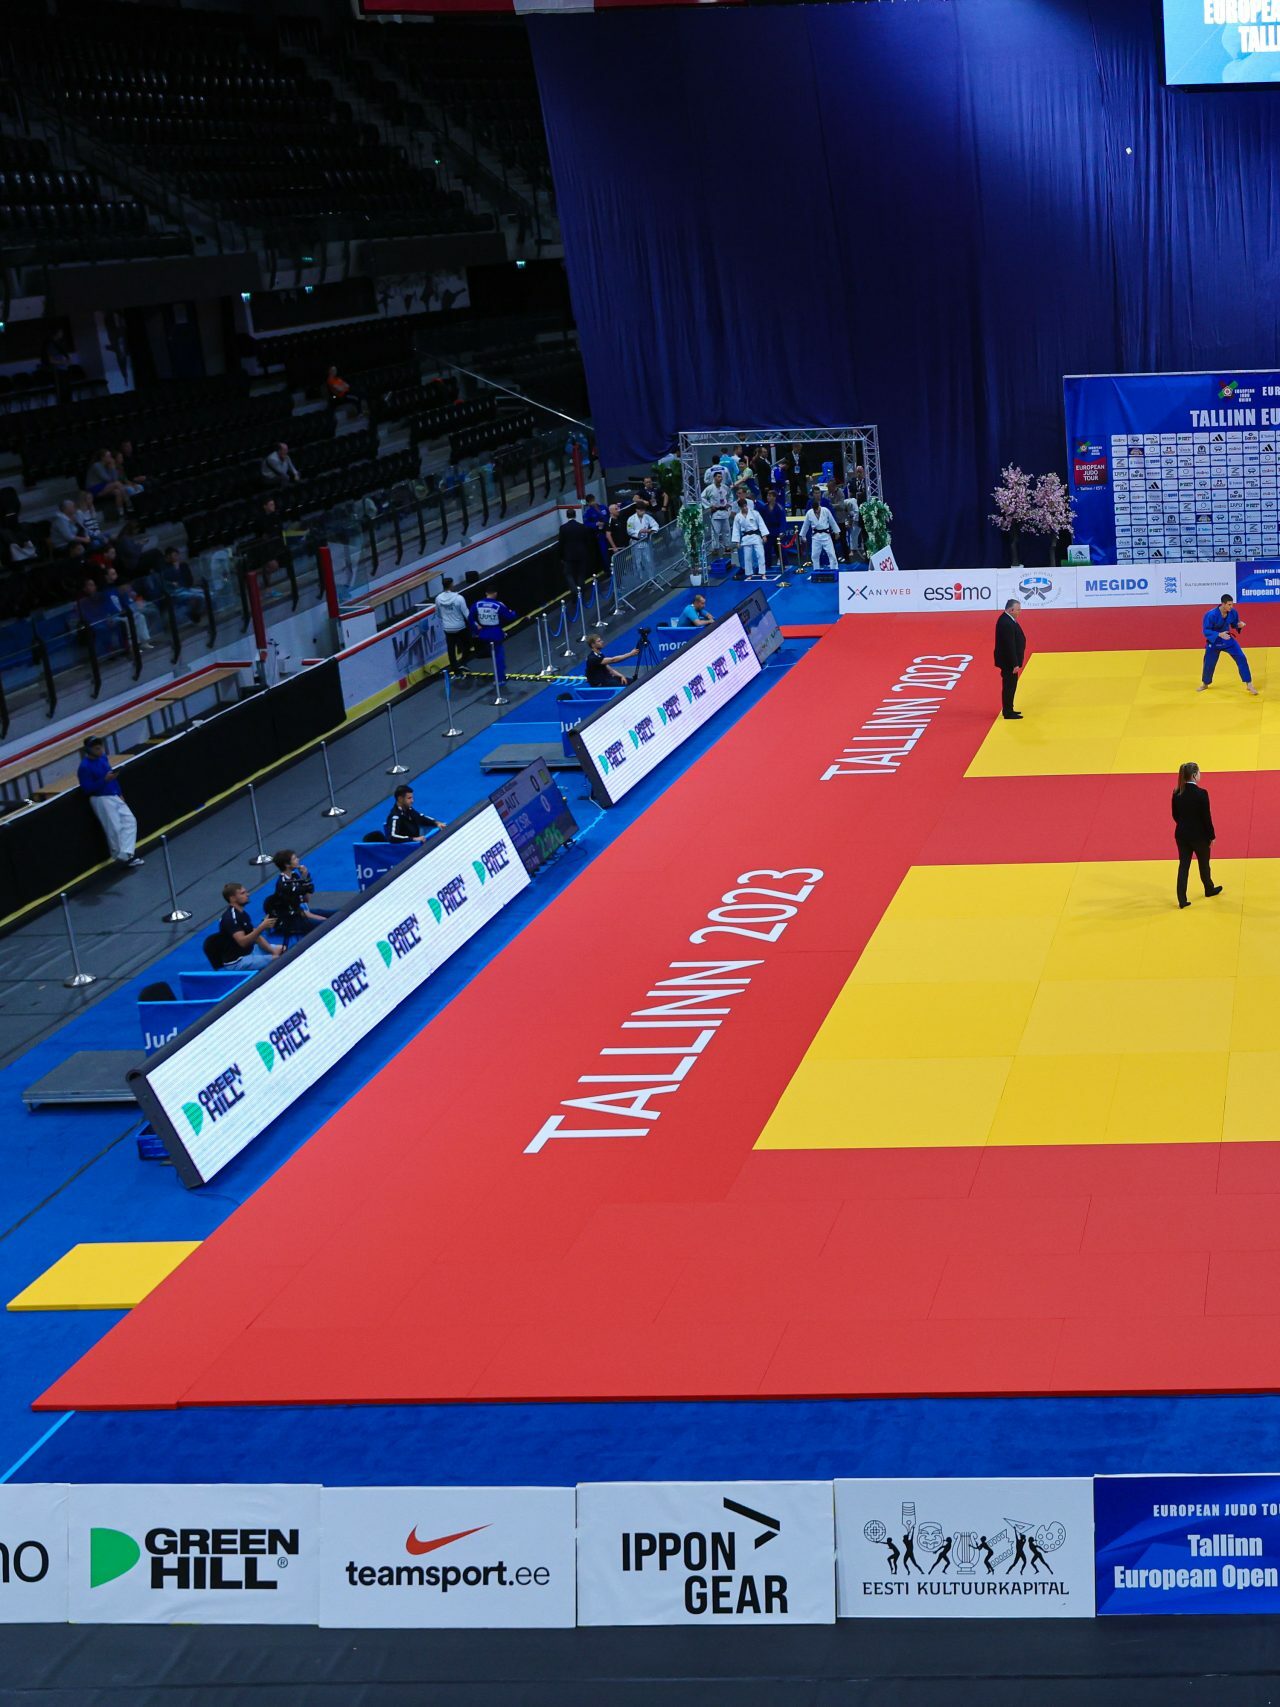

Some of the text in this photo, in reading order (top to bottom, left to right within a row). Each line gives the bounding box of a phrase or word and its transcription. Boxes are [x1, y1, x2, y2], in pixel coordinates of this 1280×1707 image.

[1190, 408, 1256, 427] TALLINN
[868, 587, 911, 596] ANYWEB
[924, 582, 991, 601] essimo
[1085, 578, 1149, 591] MEGIDO
[1242, 588, 1274, 596] European
[820, 654, 974, 781] TALLINN 2023
[522, 868, 825, 1154] TALLINN 2023
[206, 1084, 246, 1123] HILL
[1153, 1504, 1220, 1517] EUROPEAN
[1224, 1503, 1257, 1517] JUDO
[144, 1527, 300, 1556] GREEN
[621, 1531, 736, 1572] IPPON
[1187, 1533, 1263, 1557] Tallinn
[345, 1560, 551, 1593] teamsport.ee
[863, 1580, 1070, 1596] EESTI KULTUURKAPITAL
[1114, 1565, 1218, 1590] European
[1222, 1565, 1278, 1590] Open
[684, 1574, 789, 1615] GEAR
